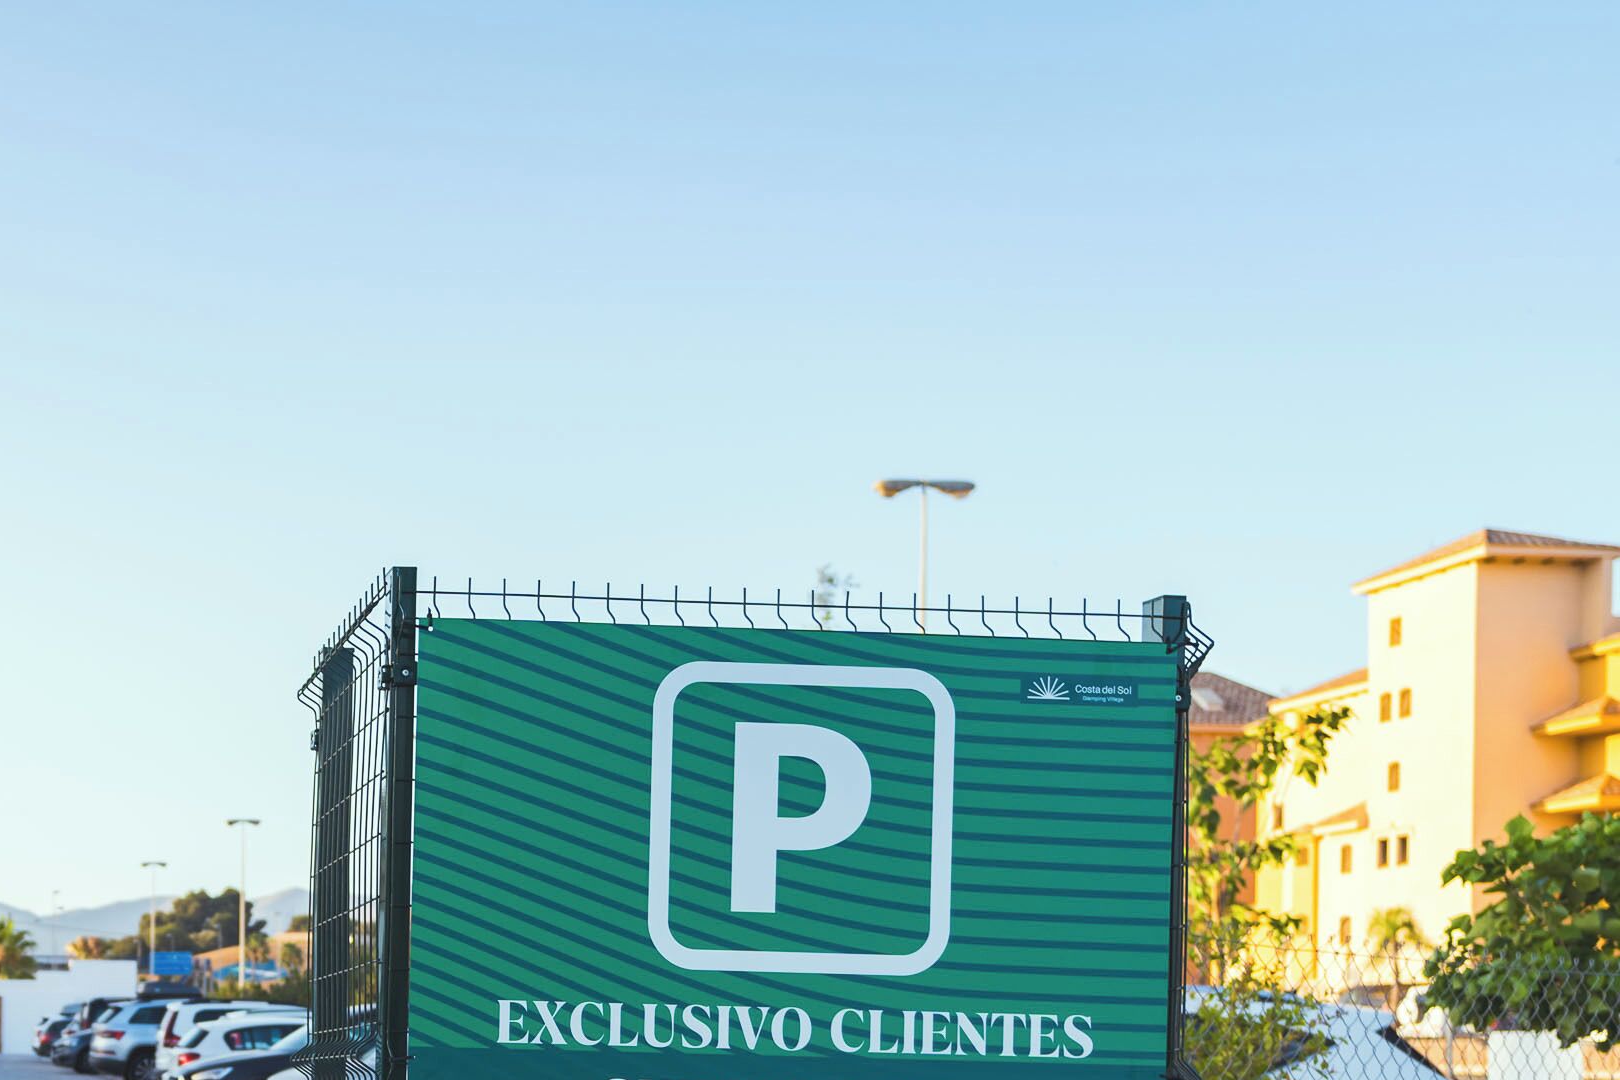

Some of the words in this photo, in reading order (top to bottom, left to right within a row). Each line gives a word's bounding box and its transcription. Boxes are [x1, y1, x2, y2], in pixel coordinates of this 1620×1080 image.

[1074, 684, 1101, 694] Costa
[1101, 685, 1116, 695] del
[1117, 685, 1132, 695] Sol
[731, 722, 871, 913] P
[496, 999, 812, 1051] EXCLUSIVO
[830, 1008, 1094, 1059] CLIENTES
